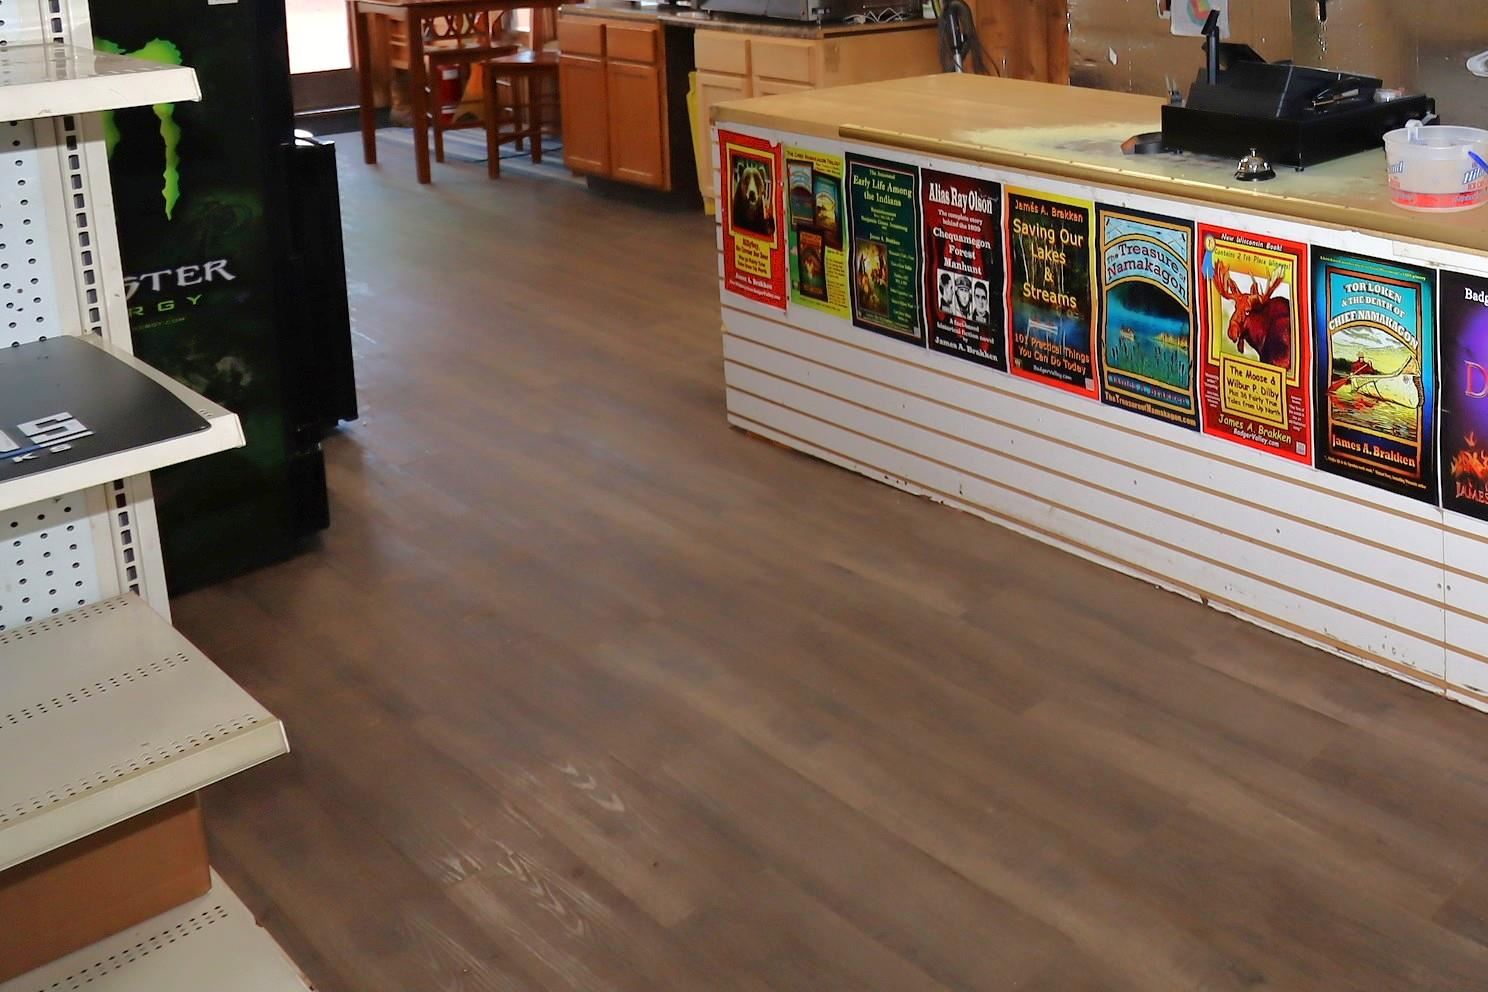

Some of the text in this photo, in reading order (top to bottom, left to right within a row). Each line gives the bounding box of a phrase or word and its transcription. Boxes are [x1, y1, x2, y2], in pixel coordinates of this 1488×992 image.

[853, 175, 912, 198] Early Life Among
[929, 182, 993, 214] Alias Ray Olson
[864, 191, 901, 206] the Indians
[1015, 199, 1084, 223] James A. Brakken
[933, 226, 991, 249] Chequamegon
[1013, 218, 1084, 247] Saving Our
[1221, 233, 1283, 251] New Wisconsin Book!
[949, 244, 976, 260] Forest
[1031, 242, 1066, 265] Lakes
[1107, 252, 1119, 264] The
[1117, 242, 1179, 274] Treasure
[944, 256, 982, 275] Manhunt
[1044, 266, 1054, 283] &
[1107, 260, 1187, 301] Namakagon
[1022, 283, 1077, 309] Streams
[1344, 282, 1403, 304] TOR LOKEN
[1348, 296, 1365, 305] THE
[1365, 296, 1393, 312] DEATH
[1392, 307, 1406, 319] OF
[1329, 310, 1419, 349] CHIEF NAMAKAGON
[1019, 345, 1086, 376] You Can Do Today
[1064, 347, 1089, 364] Things
[1230, 365, 1276, 386] The Moose &
[1227, 377, 1279, 401] Wilbur P. Dilby
[1227, 396, 1241, 406] Tales
[1264, 407, 1281, 417] North
[1218, 413, 1292, 444] James A. Brakken
[1233, 427, 1279, 448] BadgerValley.com
[1332, 434, 1416, 468] James A. Brakken
